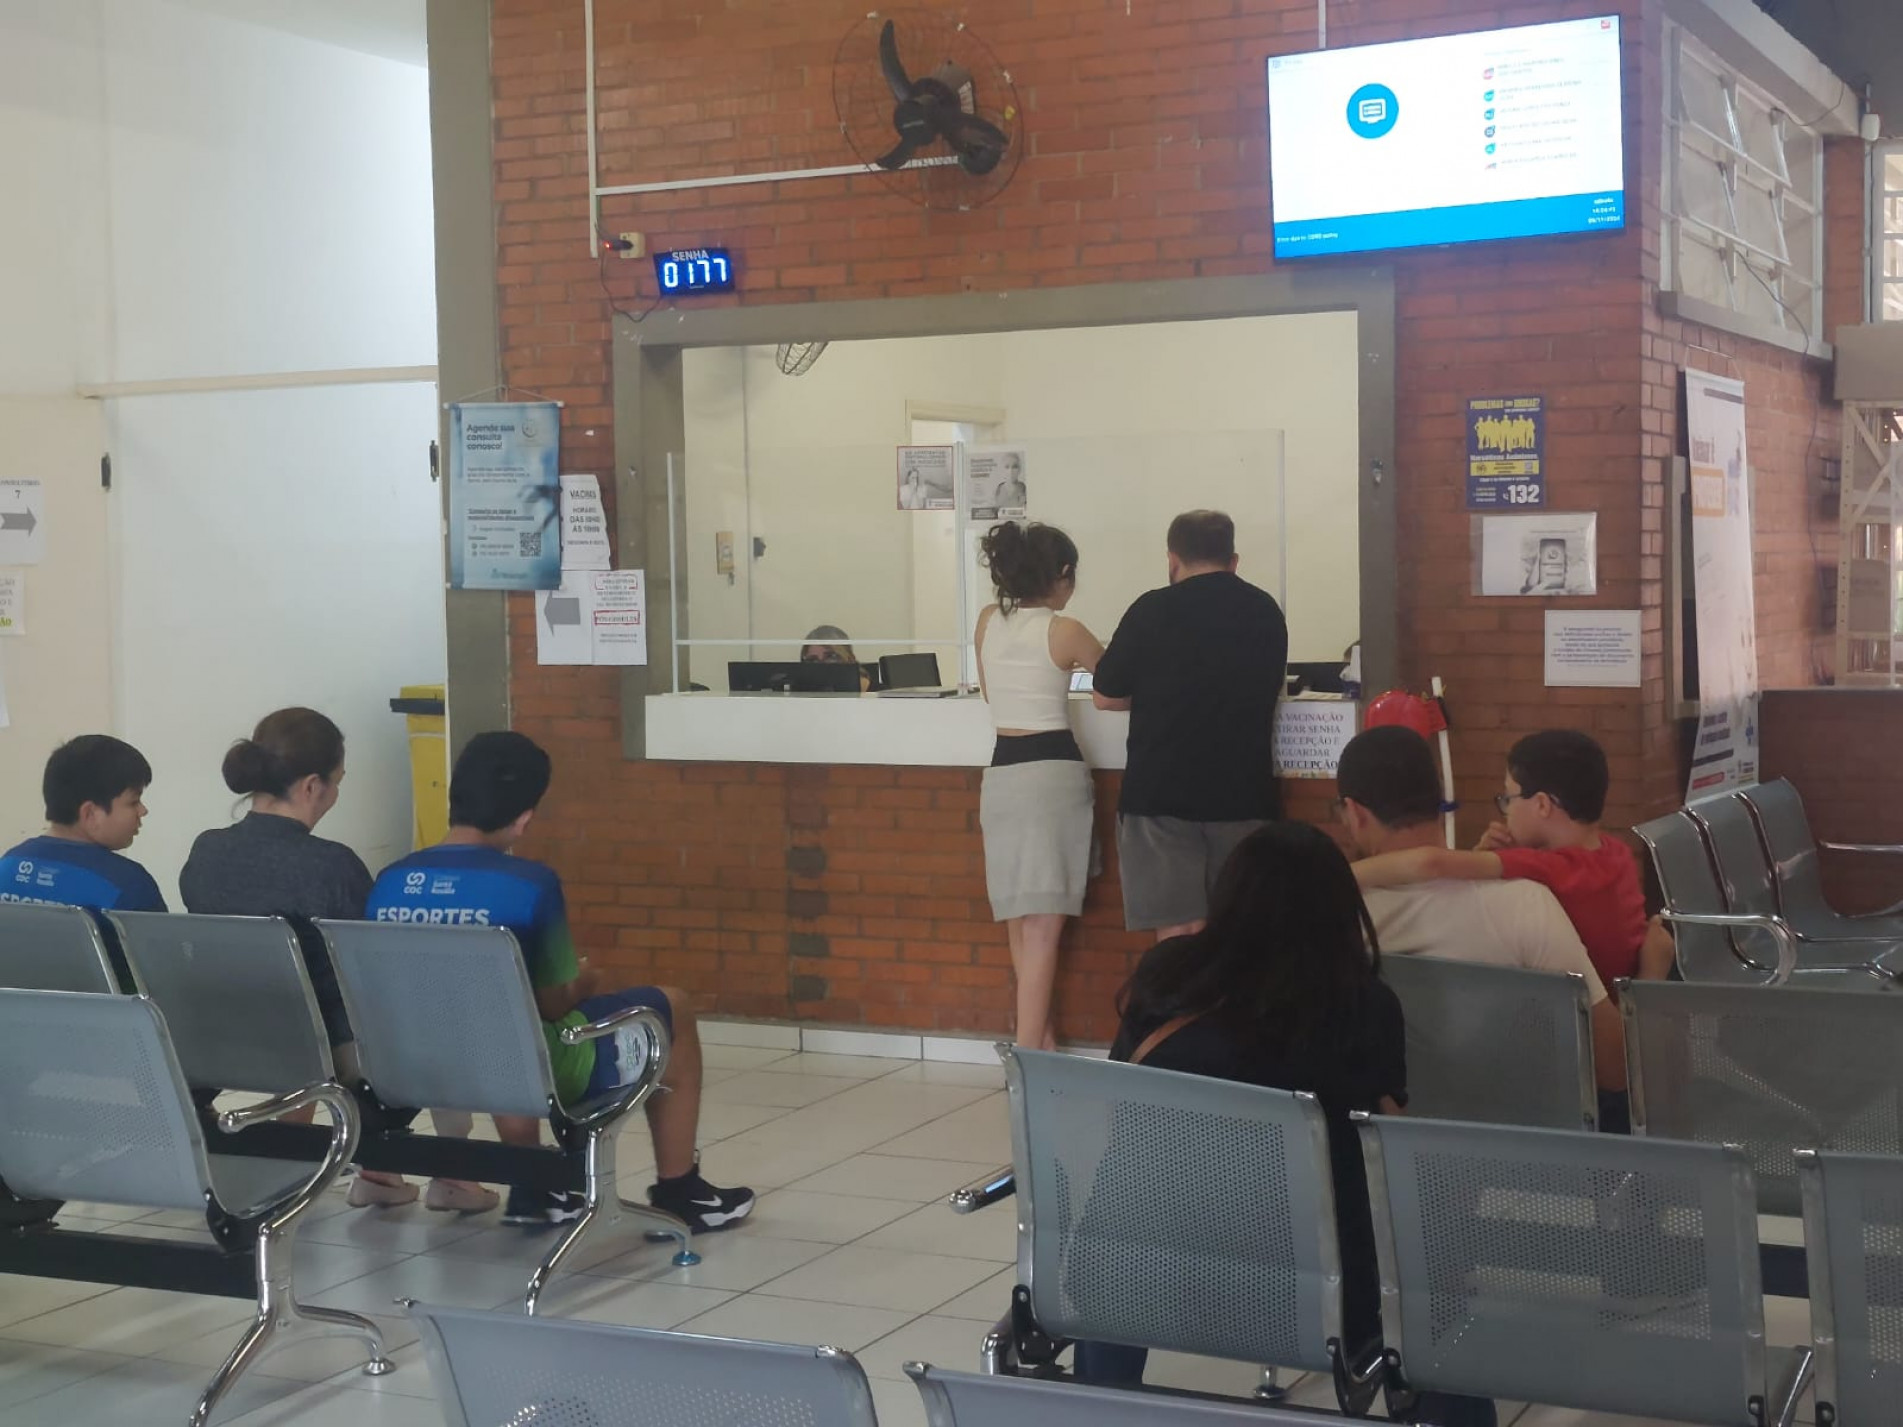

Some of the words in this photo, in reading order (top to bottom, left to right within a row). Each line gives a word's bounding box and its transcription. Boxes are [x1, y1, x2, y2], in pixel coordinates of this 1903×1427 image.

[672, 250, 709, 262] SENHA
[664, 258, 727, 288] 0177
[14, 489, 22, 499] 7
[1507, 484, 1540, 503] 132
[1285, 711, 1344, 722] VACINAÇÃO
[1275, 725, 1306, 734] TIRAR
[1308, 724, 1341, 734] SENHA
[1281, 735, 1332, 748] RECEPÇÃO
[1283, 759, 1339, 771] RECEPÇÃO
[377, 906, 491, 926] ESPORTES
